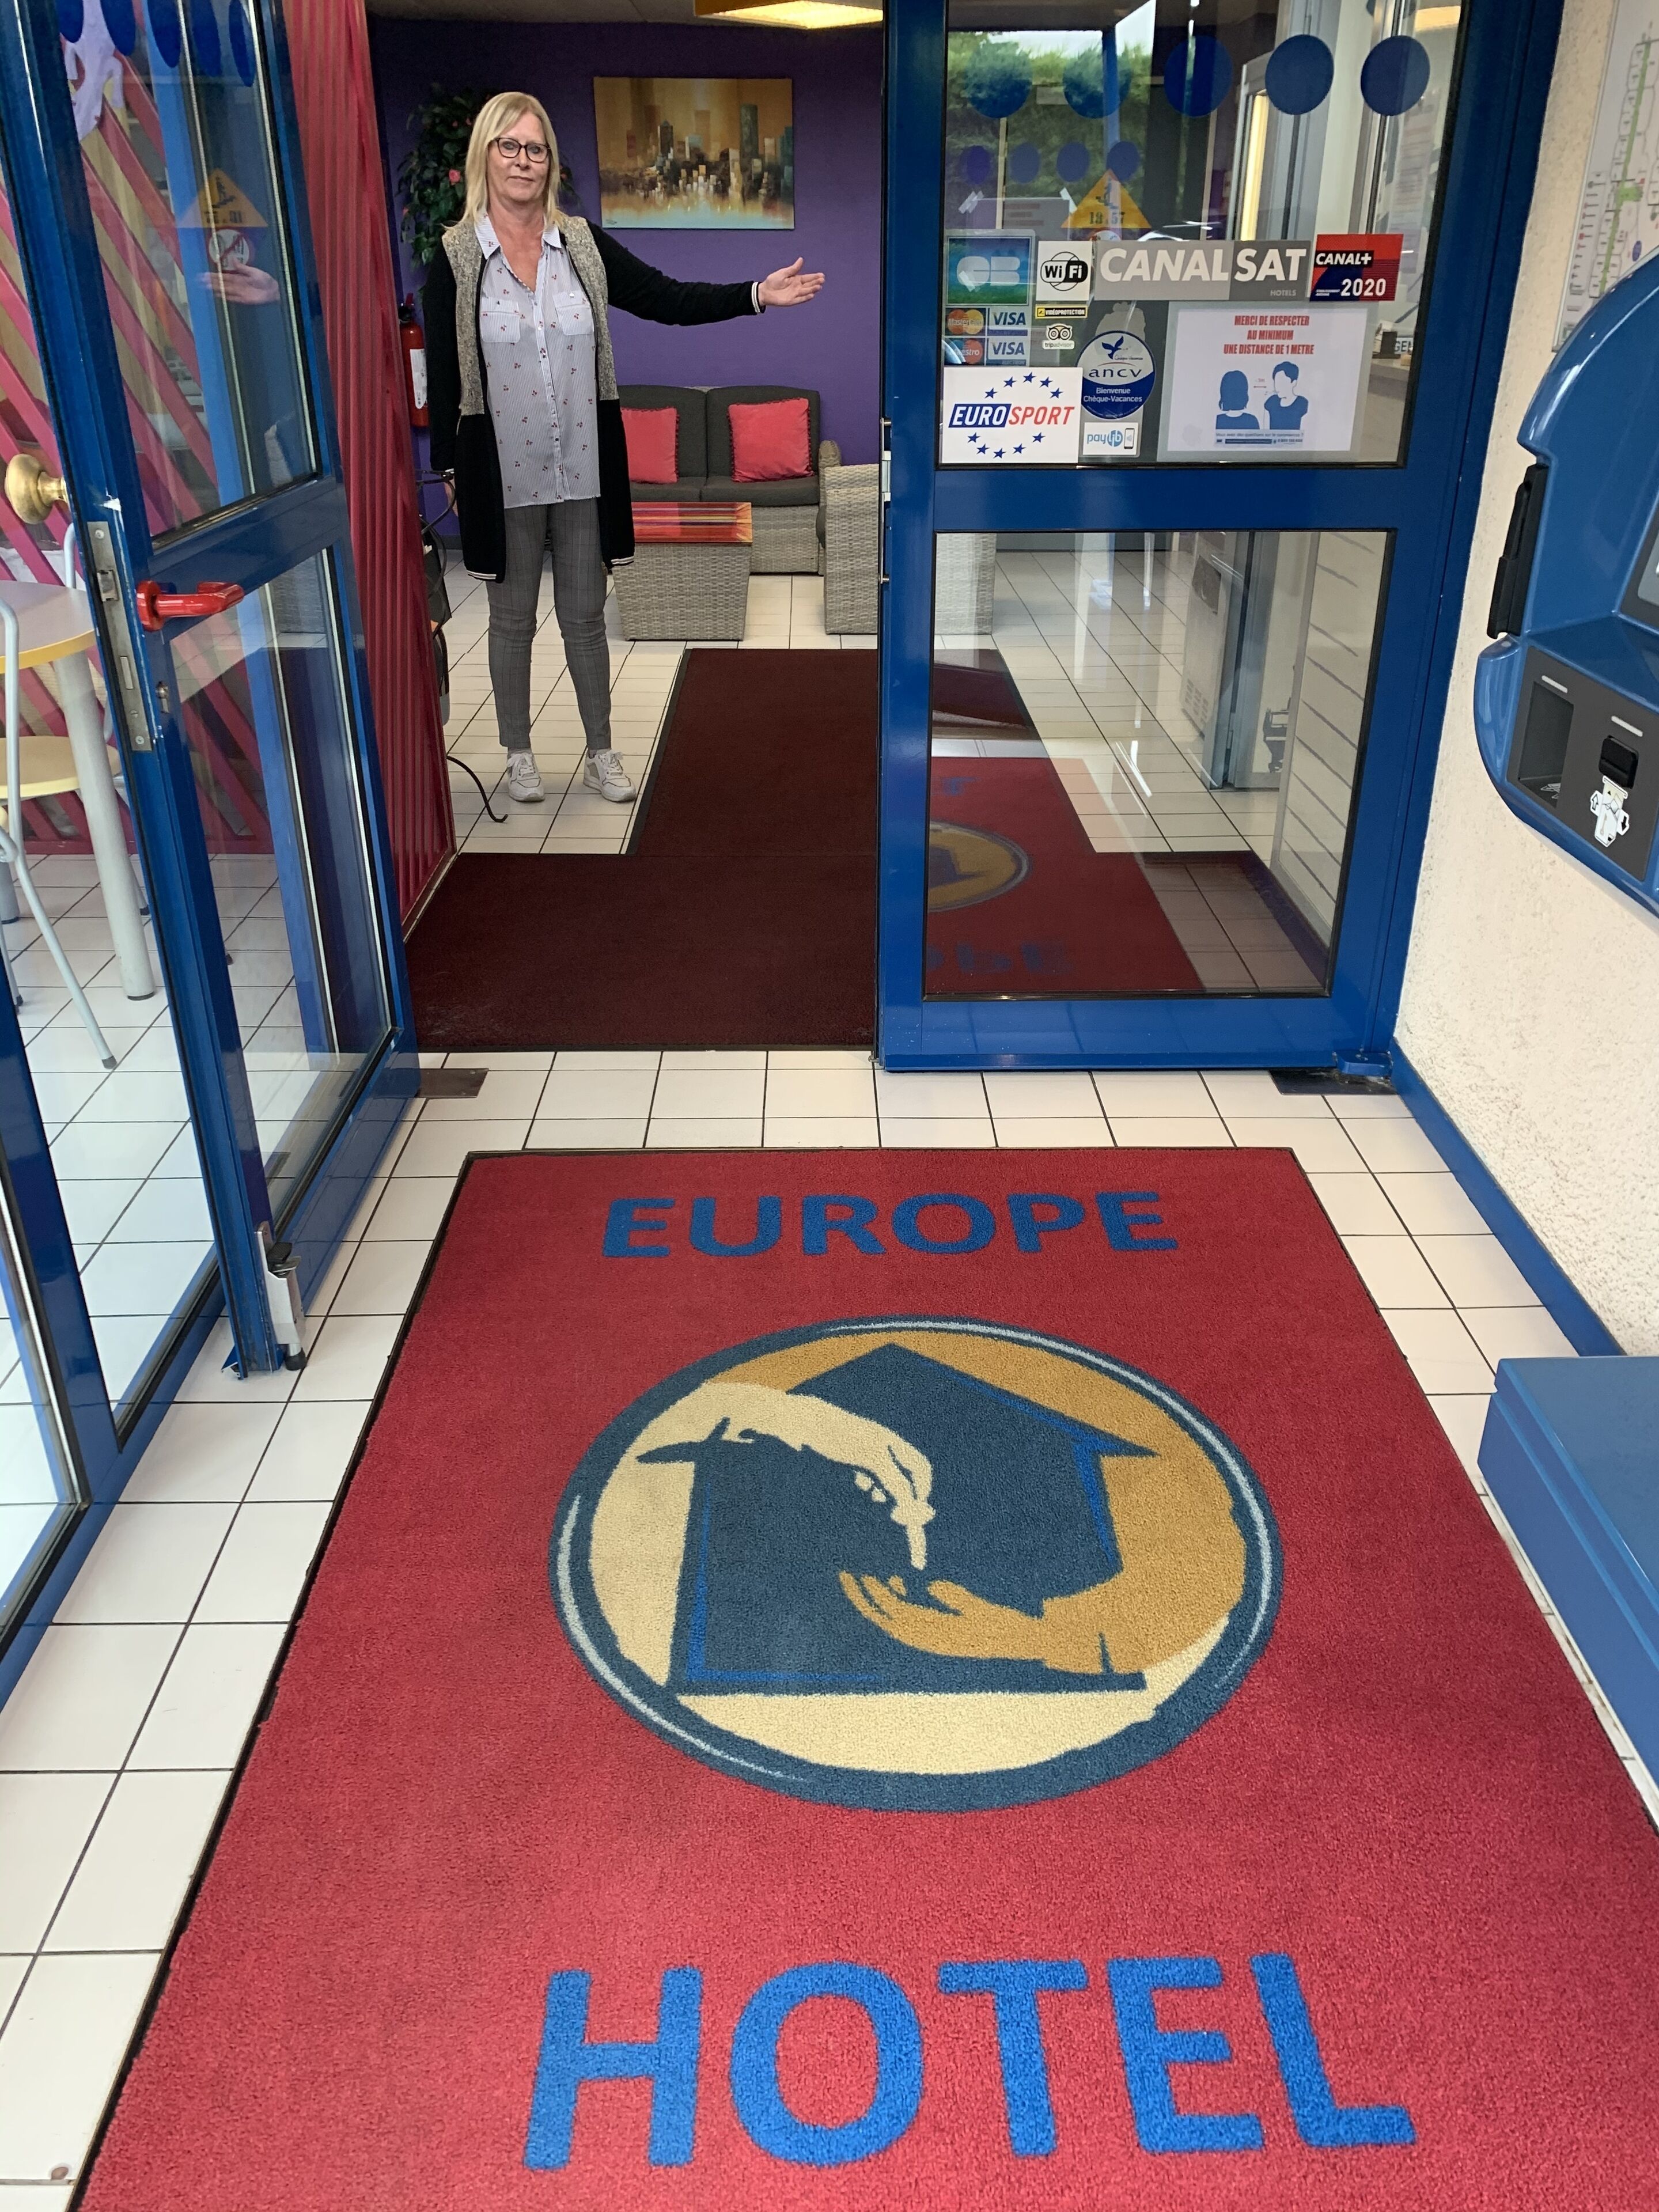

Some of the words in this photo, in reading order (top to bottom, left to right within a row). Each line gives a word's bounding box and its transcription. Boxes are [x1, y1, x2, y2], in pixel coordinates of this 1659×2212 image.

[1316, 253, 1372, 265] CANAL+
[1340, 278, 1386, 297] 2020
[993, 312, 1026, 325] VISA
[1234, 315, 1257, 326] MERCI
[1259, 316, 1268, 326] DE
[1269, 316, 1310, 326] RESPECTER
[1247, 330, 1257, 340] AU
[1258, 330, 1294, 340] MINIMUM
[992, 342, 1025, 355] VISA
[1224, 344, 1237, 354] UNE
[1239, 344, 1274, 354] DISTANCE
[1275, 344, 1285, 354] DE
[1286, 344, 1289, 354] 1
[1088, 369, 1142, 377] ancv
[1083, 395, 1143, 403] Chèque-Vacances
[602, 1191, 1177, 1257] EUROPE
[522, 1952, 1416, 2171] HOTEL
